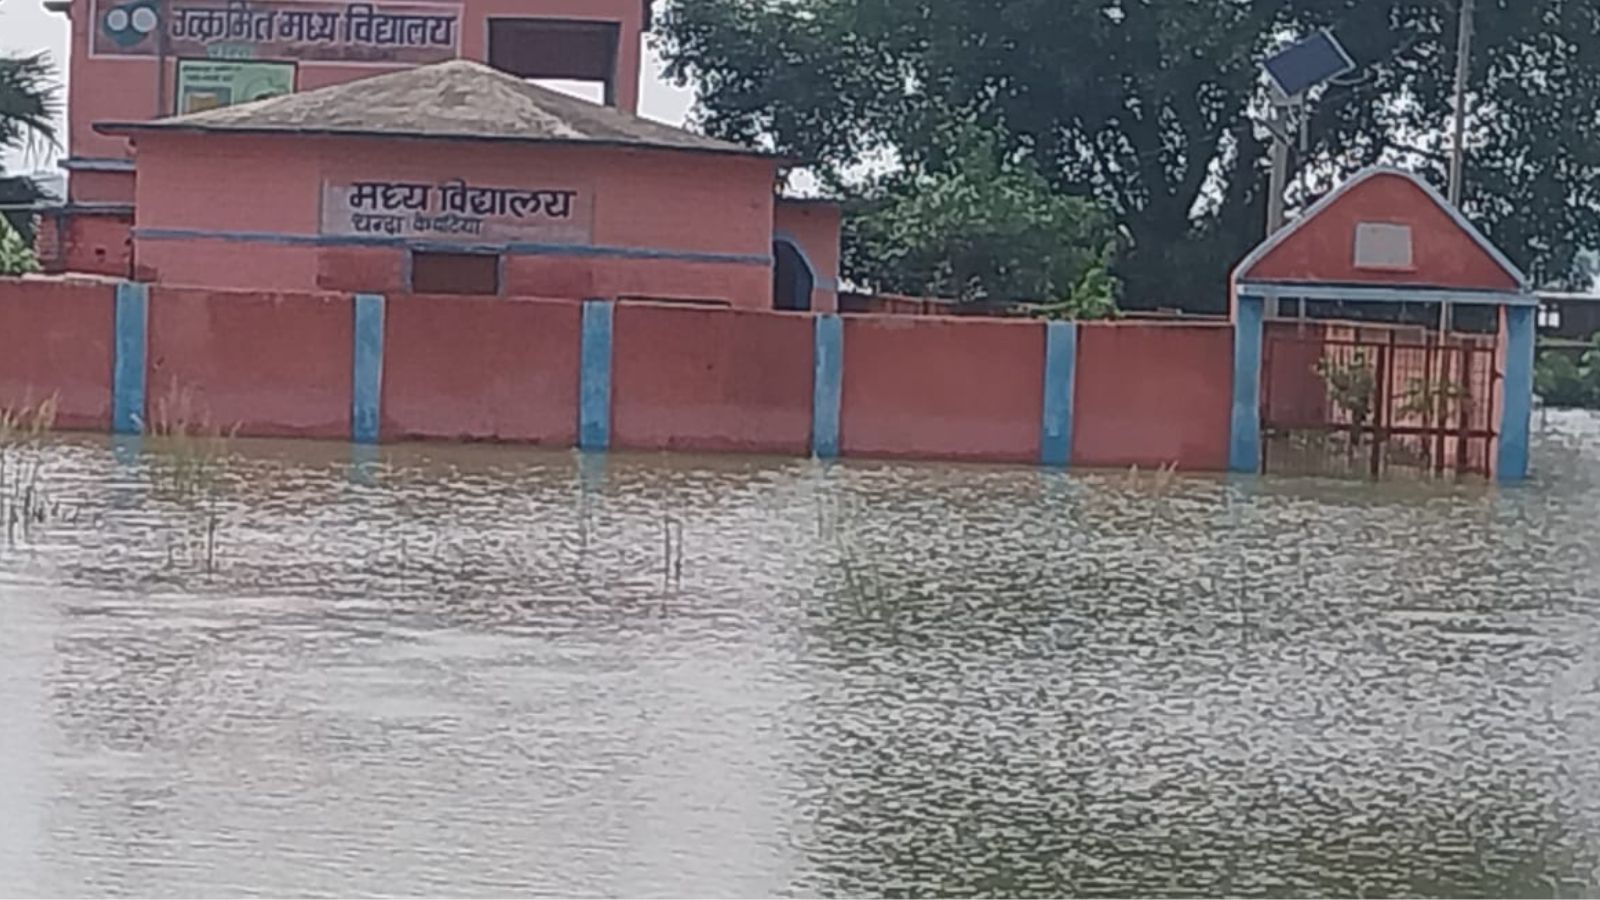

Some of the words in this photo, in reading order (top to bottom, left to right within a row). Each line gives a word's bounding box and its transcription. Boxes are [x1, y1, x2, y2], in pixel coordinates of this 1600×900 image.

[279, 11, 336, 42] मध्य
[344, 3, 455, 45] विद्यालय
[350, 181, 432, 211] मध्य
[438, 178, 577, 218] विद्यालय
